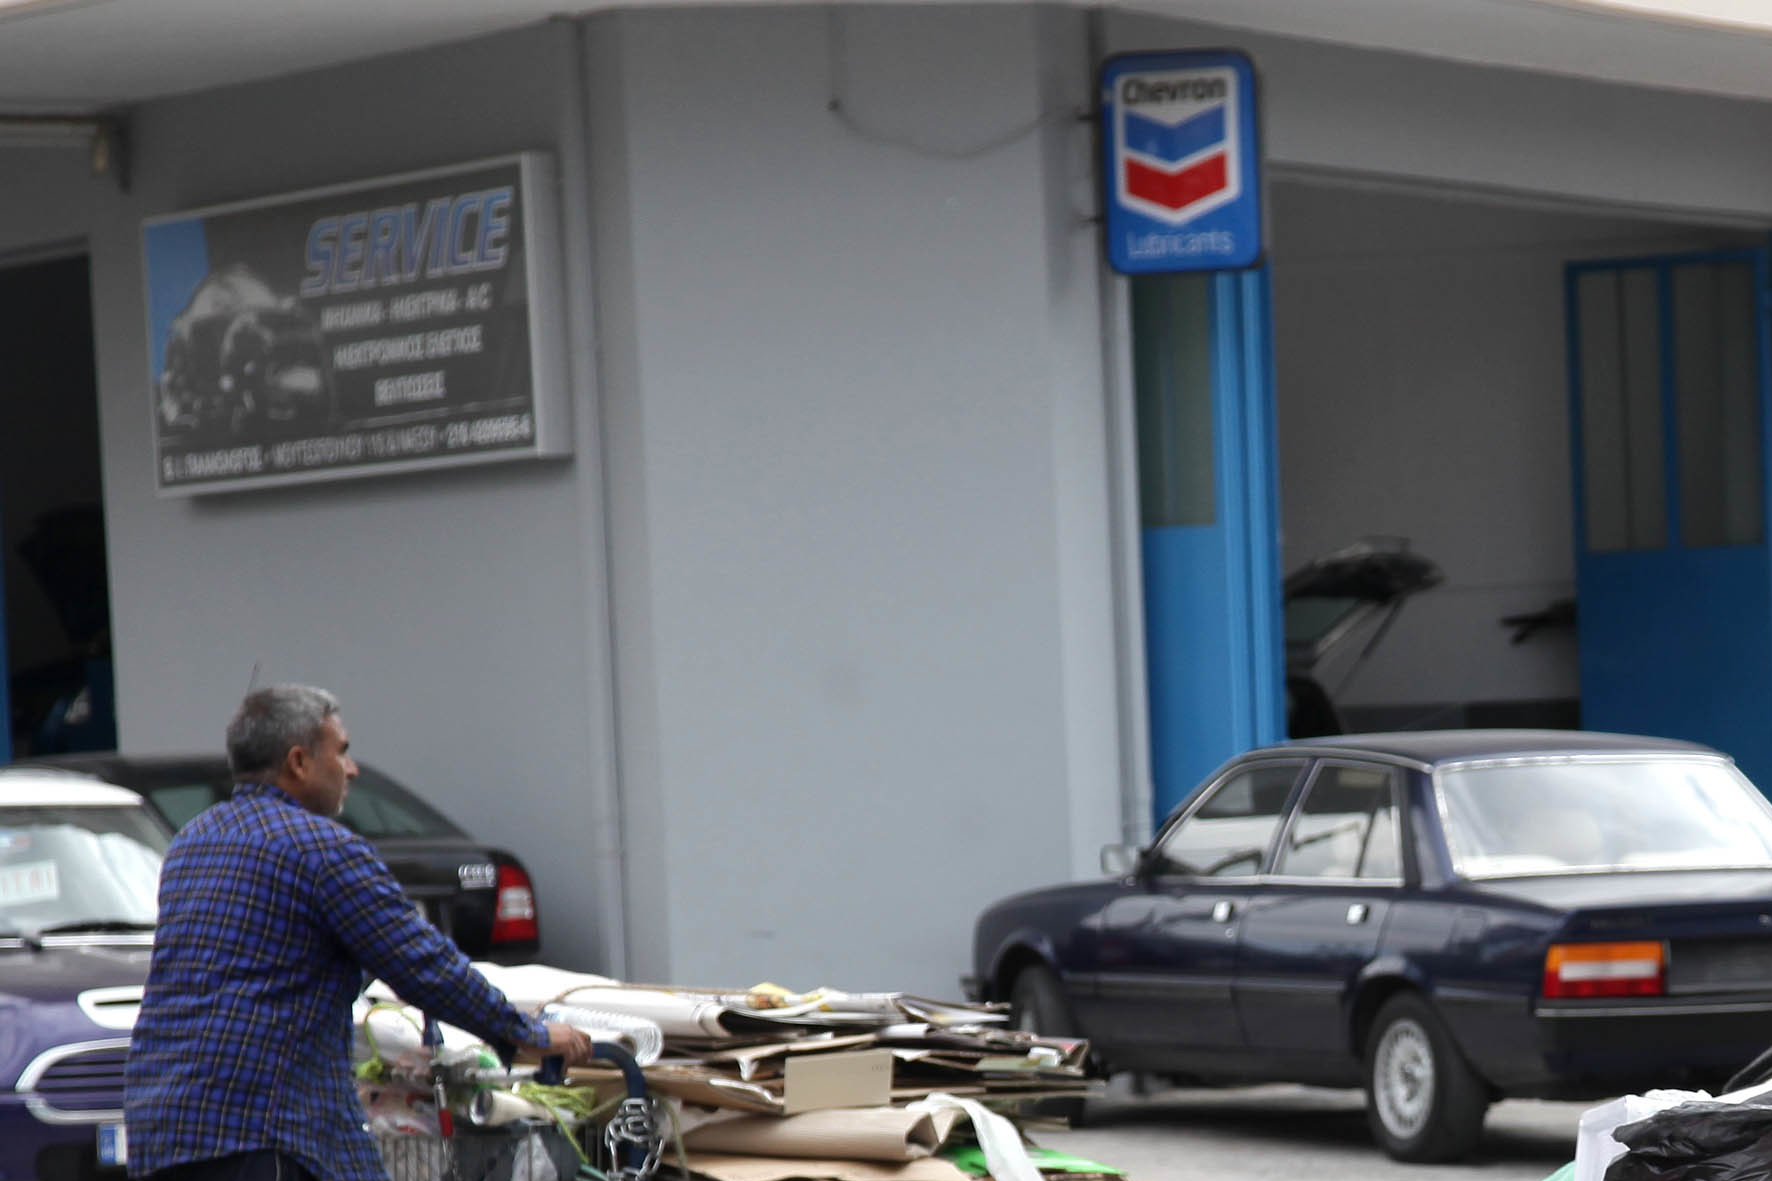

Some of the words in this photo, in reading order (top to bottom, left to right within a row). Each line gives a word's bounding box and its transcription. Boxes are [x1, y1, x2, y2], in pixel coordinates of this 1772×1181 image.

[1122, 76, 1228, 105] Chevron
[301, 186, 513, 298] SERVICE
[1126, 231, 1234, 259] Lubricants
